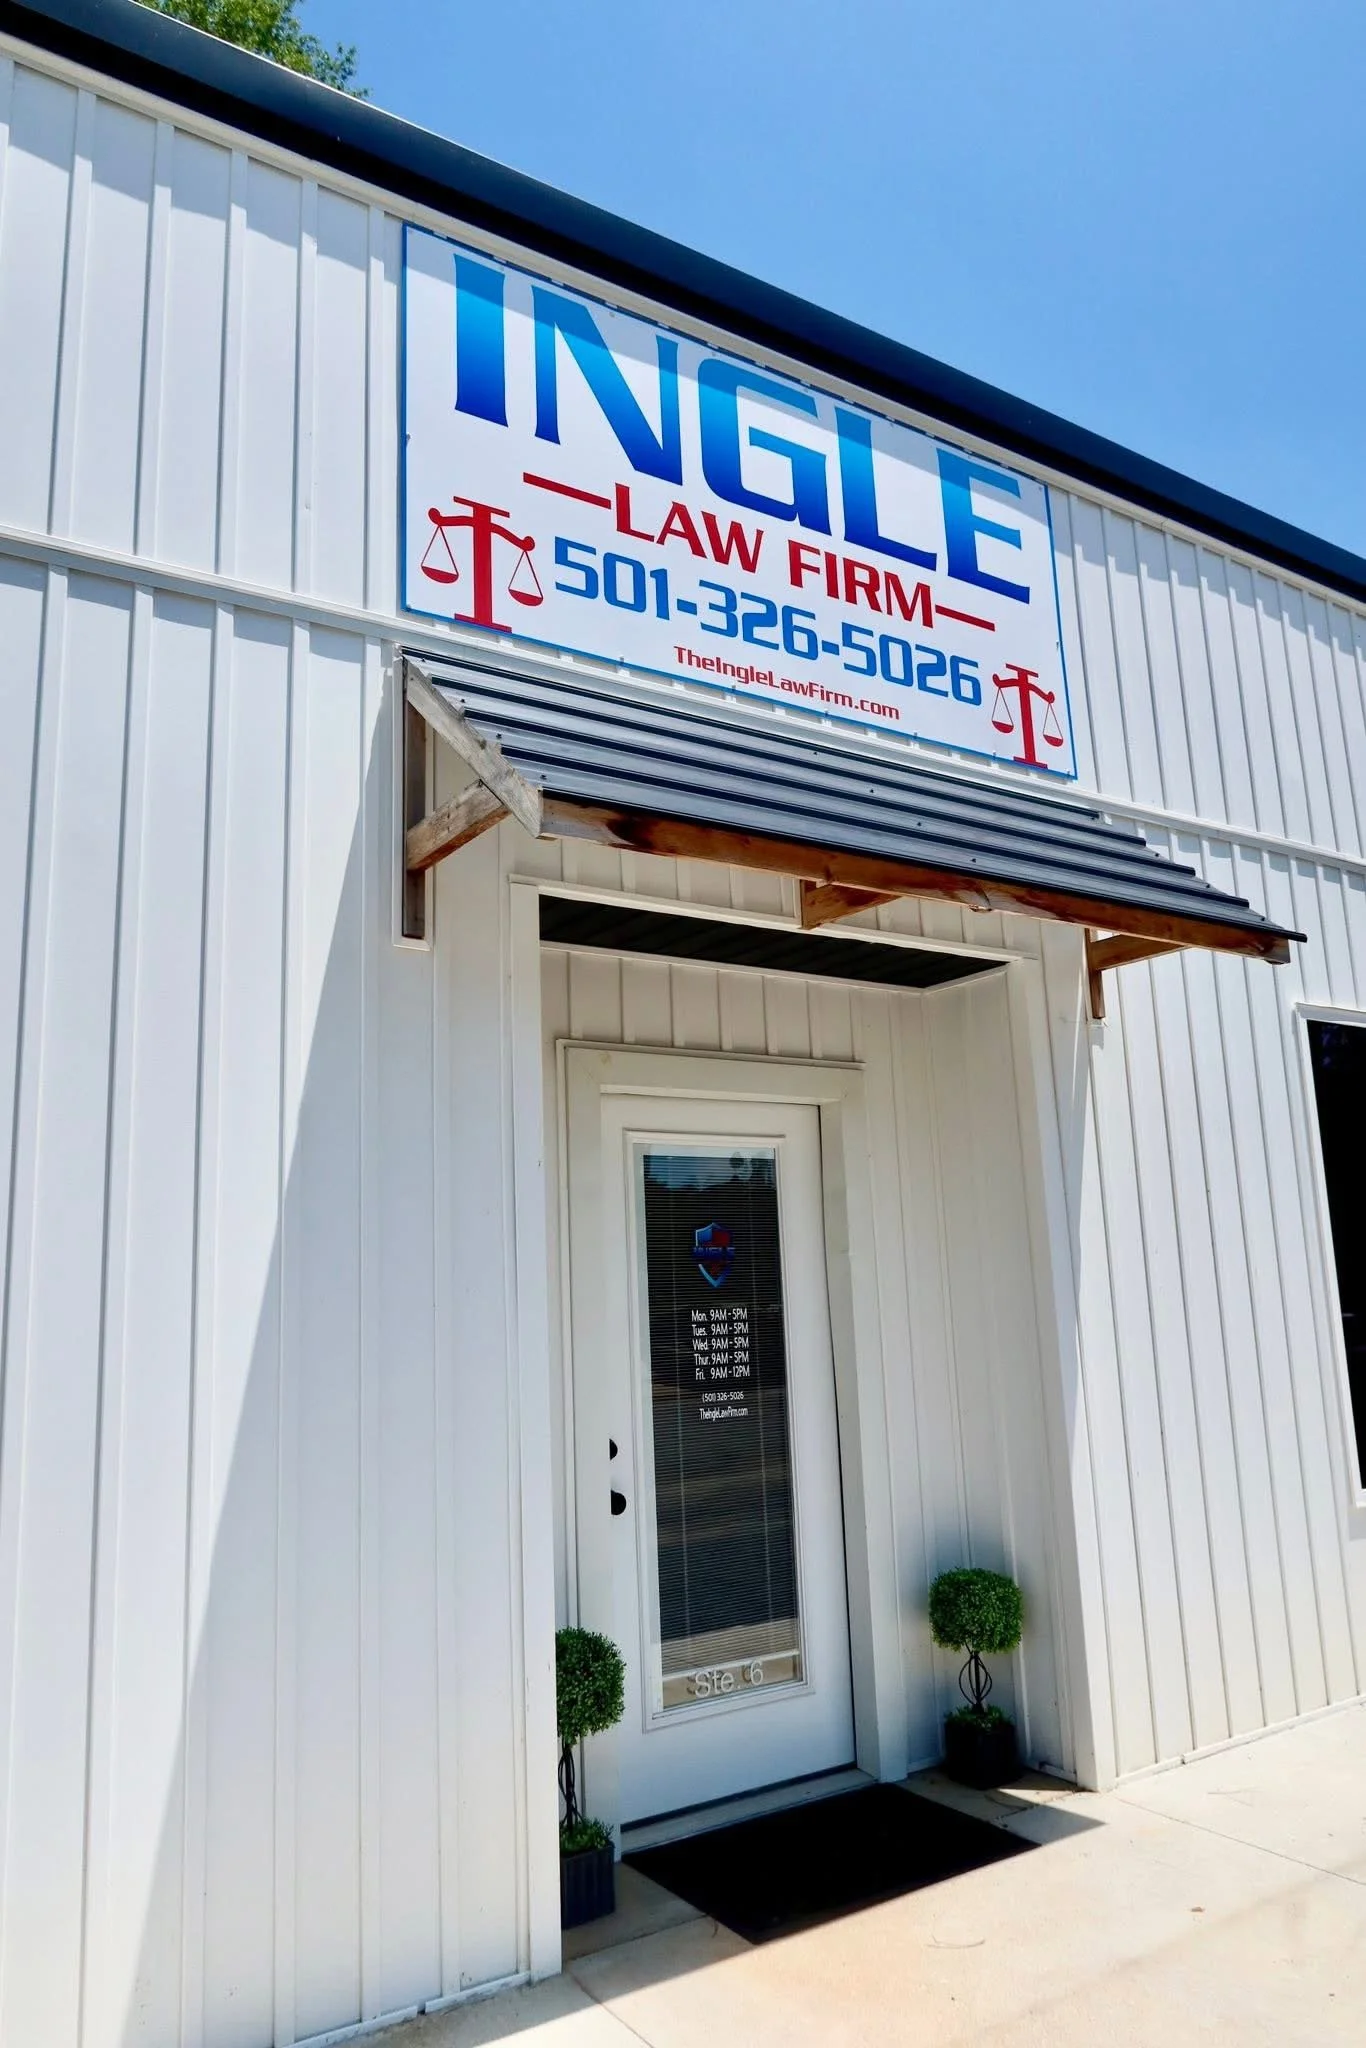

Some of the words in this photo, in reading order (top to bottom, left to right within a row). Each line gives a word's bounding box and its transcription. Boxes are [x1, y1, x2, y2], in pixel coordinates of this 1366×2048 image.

[454, 253, 1030, 604] INGLE
[615, 483, 764, 573] LAW
[788, 539, 934, 629] FIRM
[554, 537, 982, 706] 501-326-5026
[673, 645, 900, 720] TheIngleLawFirm.com
[691, 1309, 707, 1322] Mon.
[710, 1308, 727, 1321] 9AM
[732, 1307, 748, 1320] 5PM
[691, 1324, 708, 1336] Tues.
[710, 1323, 729, 1336] 9AM
[733, 1322, 749, 1334] 5PM
[711, 1337, 729, 1350] 9AM
[694, 1353, 711, 1366] Thur.
[711, 1352, 729, 1365] 9AM
[734, 1350, 749, 1363] 5PM
[695, 1368, 706, 1380] Fri.
[710, 1366, 728, 1379] 9AM
[733, 1364, 750, 1378] 12PM
[716, 1391, 745, 1401] 326-5026
[750, 1659, 764, 1686] 6
